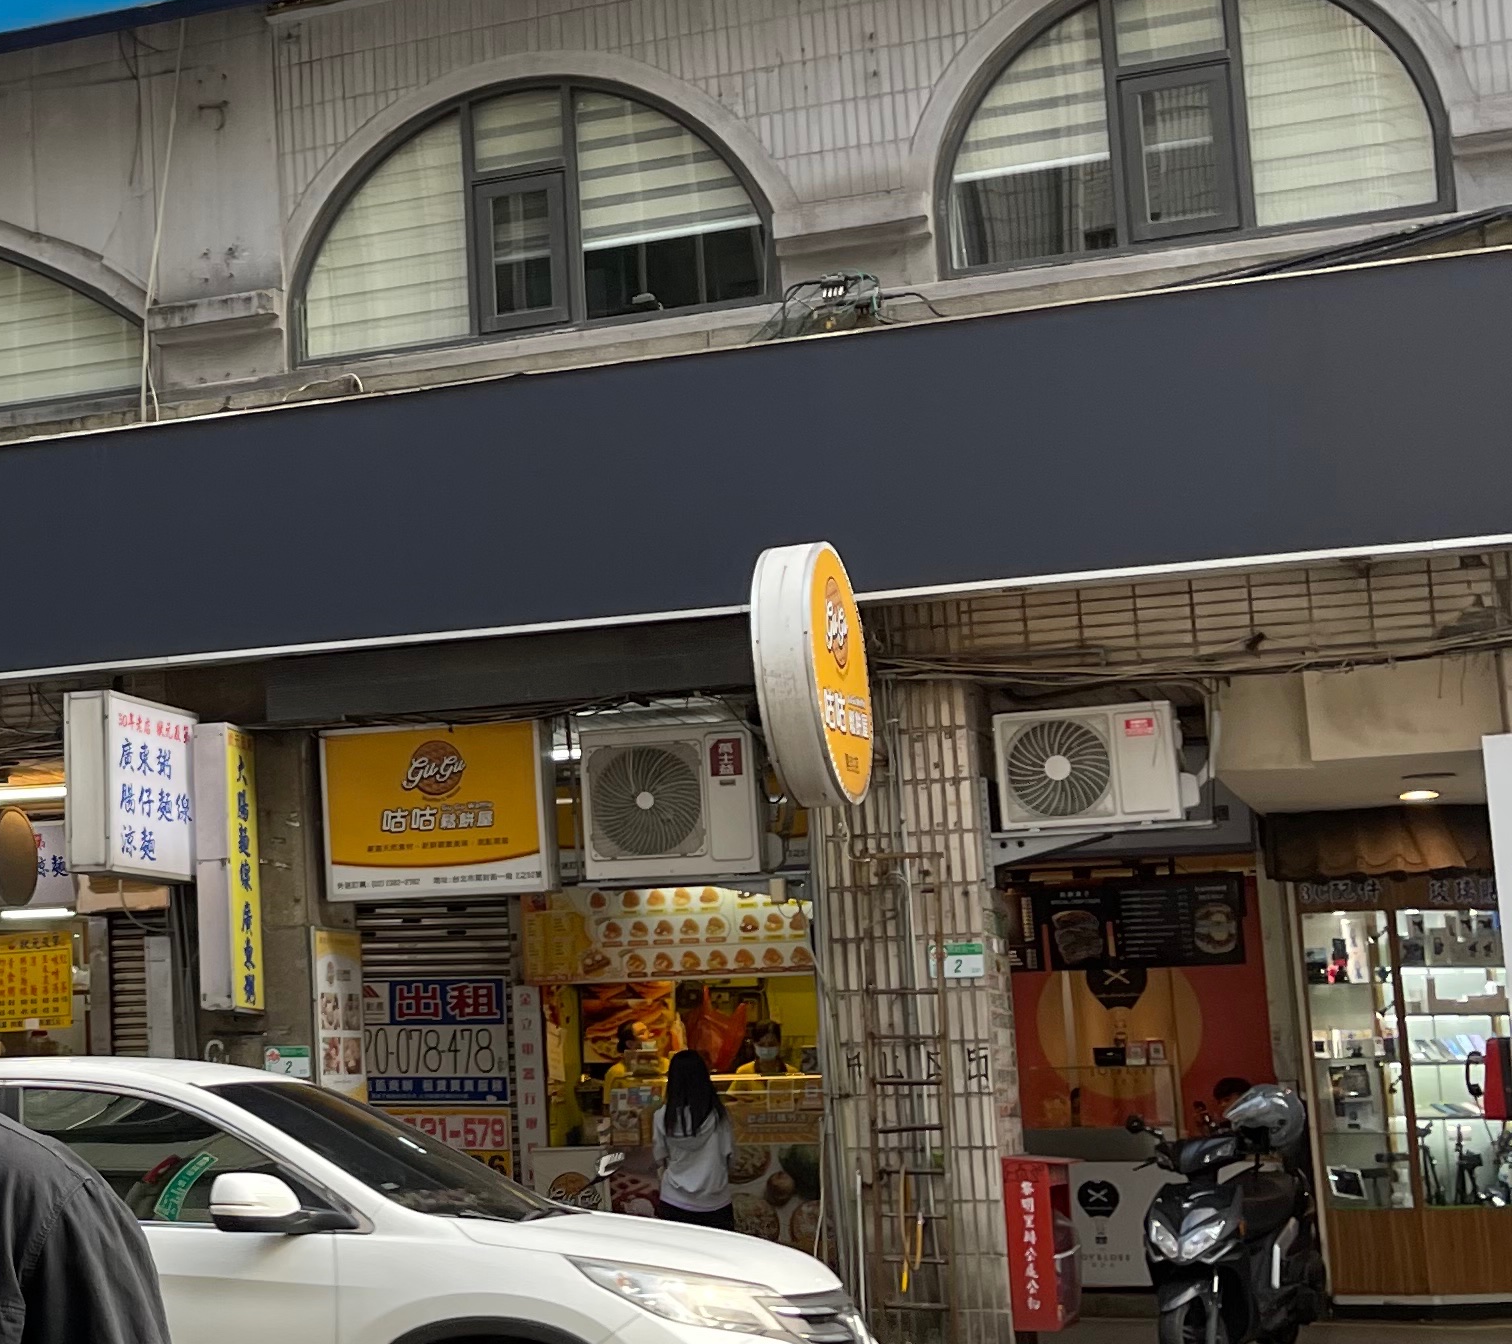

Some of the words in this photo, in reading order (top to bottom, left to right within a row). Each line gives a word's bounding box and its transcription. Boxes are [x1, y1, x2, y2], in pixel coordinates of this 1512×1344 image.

[119, 738, 172, 781] 廣東粥
[119, 782, 193, 825] 腸仔麵線
[381, 805, 438, 834] 咕咕
[954, 959, 963, 974] 2
[396, 982, 501, 1021] 出租
[285, 1060, 293, 1074] 2
